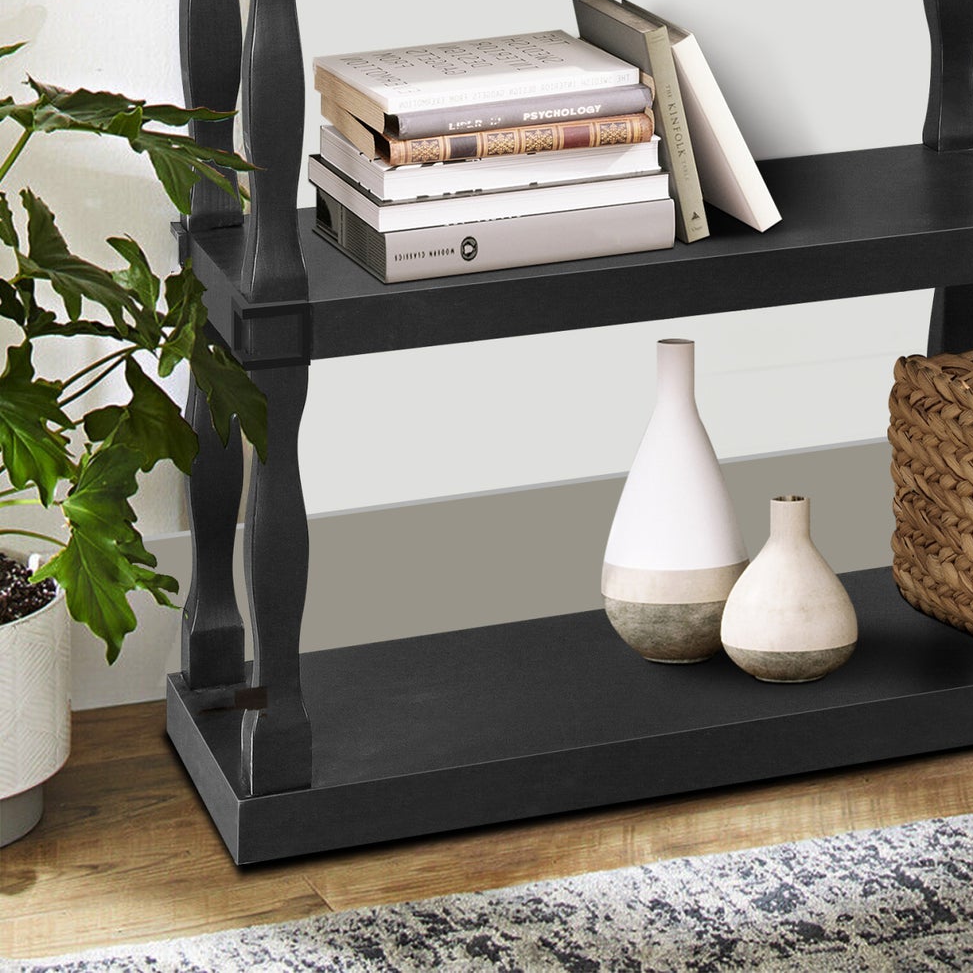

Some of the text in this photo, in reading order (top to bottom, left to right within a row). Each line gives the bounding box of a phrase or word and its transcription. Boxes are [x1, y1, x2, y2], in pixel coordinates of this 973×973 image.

[523, 104, 602, 121] PSYCHOLOGY
[668, 102, 688, 158] KINFOLK
[394, 251, 426, 262] CLASSICS
